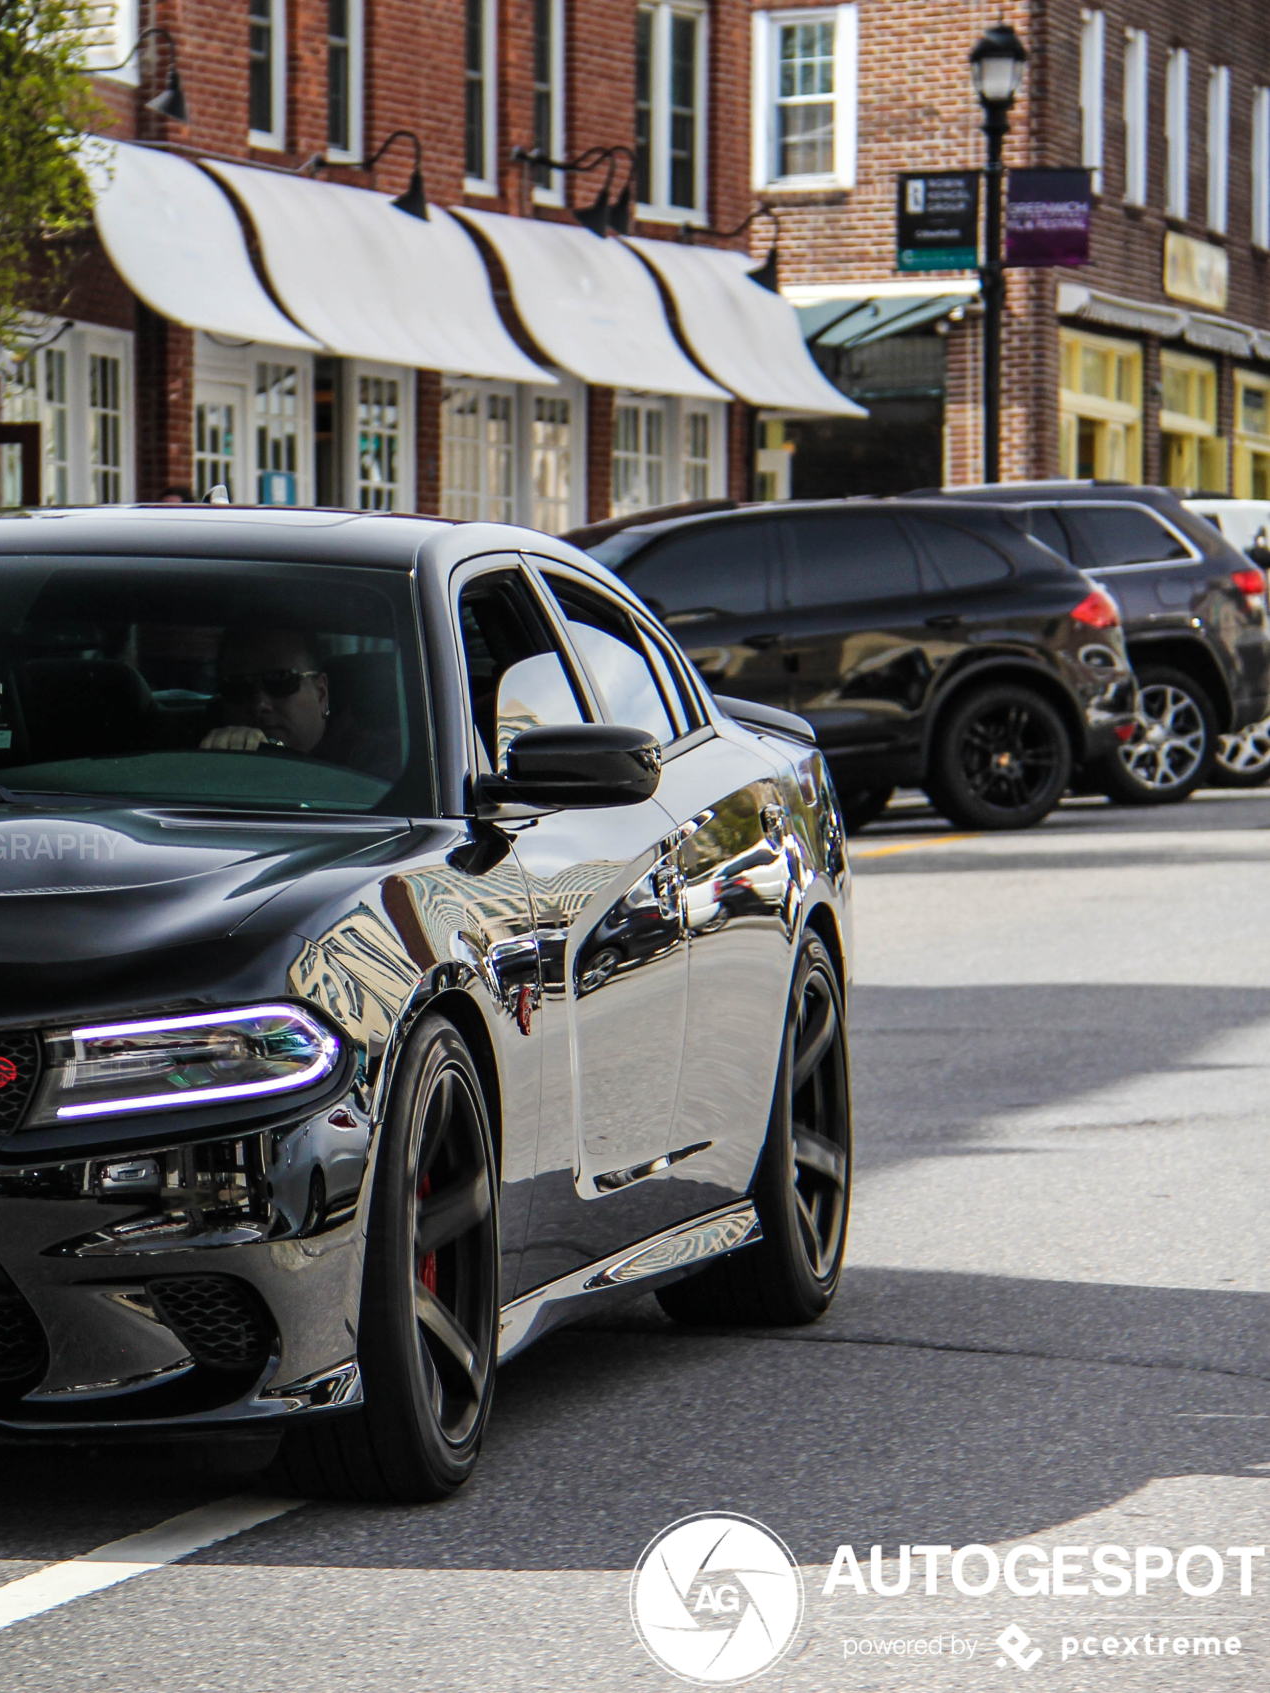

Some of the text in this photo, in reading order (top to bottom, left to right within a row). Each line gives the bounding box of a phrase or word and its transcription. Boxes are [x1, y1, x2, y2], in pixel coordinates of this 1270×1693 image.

[928, 201, 967, 211] GROUP
[1008, 201, 1089, 212] GREENWICH
[1036, 218, 1087, 229] FESTIVAL
